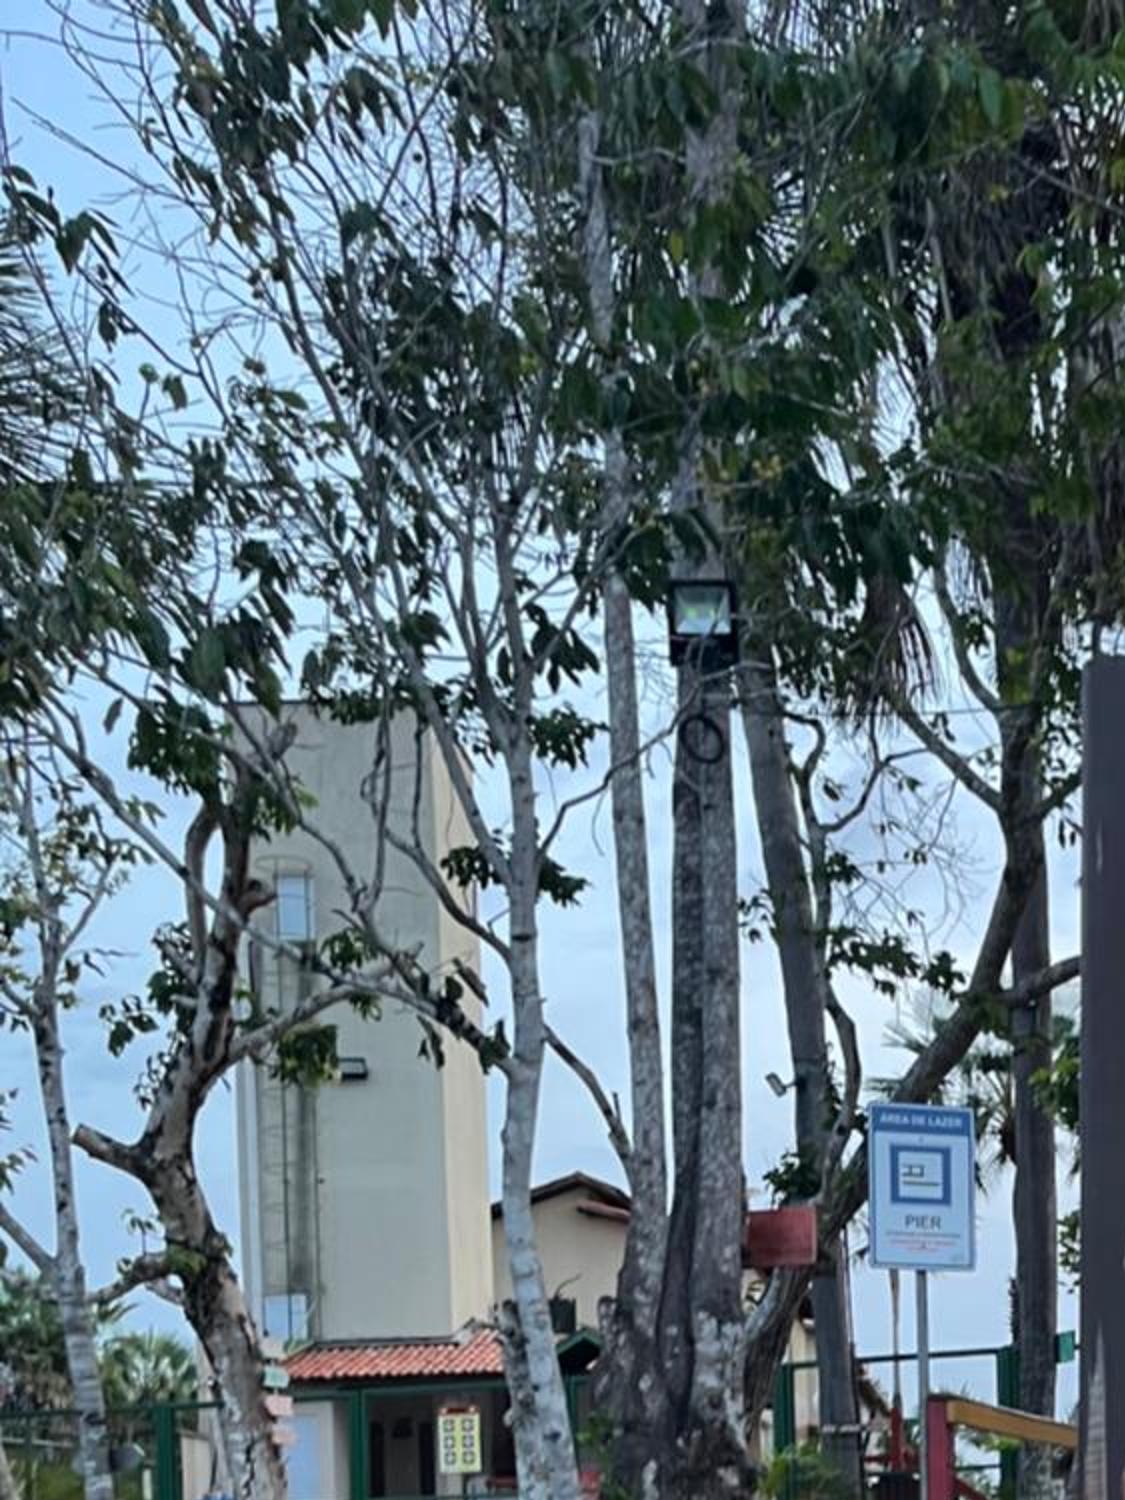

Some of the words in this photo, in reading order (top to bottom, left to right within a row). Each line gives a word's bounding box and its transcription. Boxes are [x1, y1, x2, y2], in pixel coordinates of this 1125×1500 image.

[911, 1115, 926, 1126] DE
[927, 1115, 962, 1127] LAZER
[904, 1213, 941, 1230] PIER
